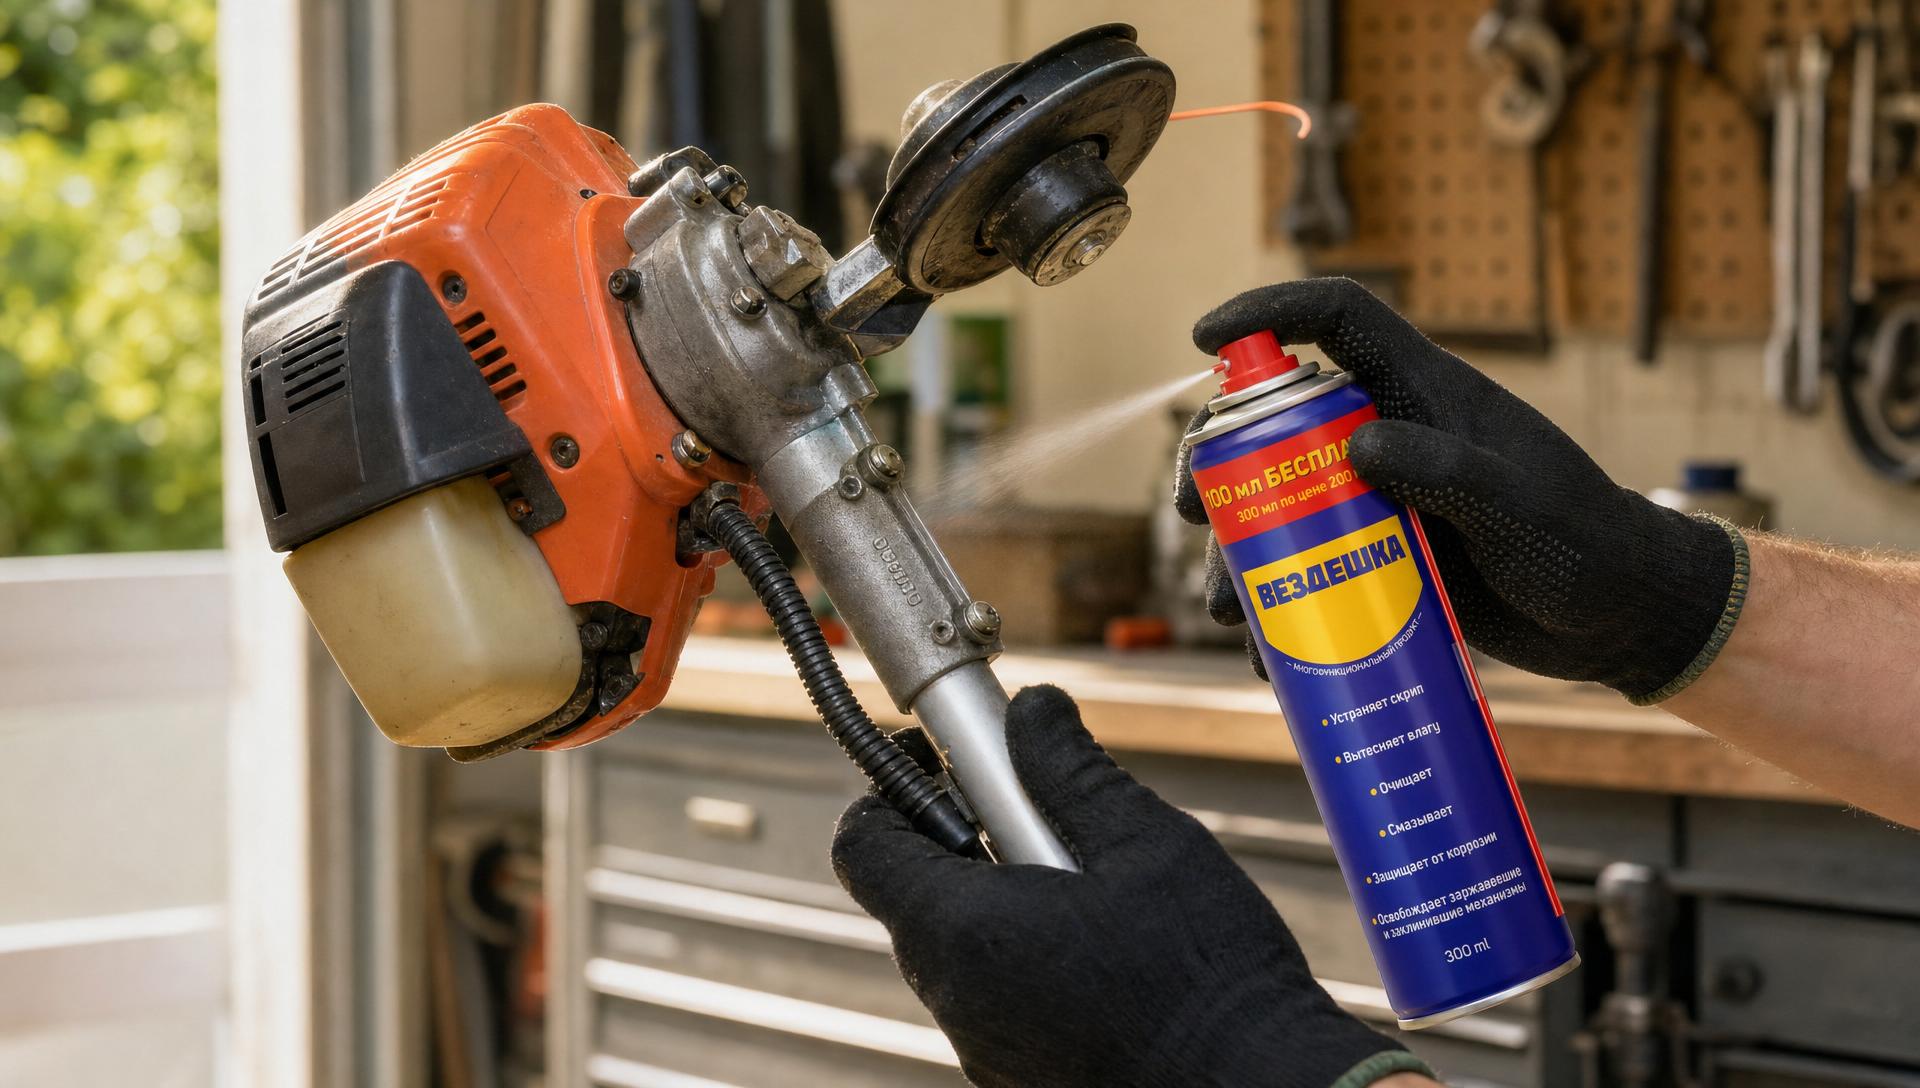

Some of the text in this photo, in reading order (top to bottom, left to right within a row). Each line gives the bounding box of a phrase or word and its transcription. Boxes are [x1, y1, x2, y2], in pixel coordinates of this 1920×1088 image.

[1205, 436, 1352, 509] 100 мл БЕСПЛА
[1236, 507, 1260, 523] 300
[1262, 500, 1278, 515] мл
[1280, 494, 1296, 509] по
[1297, 482, 1328, 505] цене
[1328, 469, 1352, 489] 200
[1256, 534, 1406, 610] ВЕЗДЕШКА
[1329, 683, 1425, 726] Устраняет скрип
[1343, 720, 1441, 764] Вытесняет влагу
[1379, 767, 1433, 795] Очищает
[1387, 805, 1453, 836] Смазывает
[1372, 831, 1498, 885] Защищает от коррозии
[1377, 896, 1447, 925] Освобождает
[1383, 882, 1527, 940] и заклинившие механизмы
[1444, 937, 1491, 964] 300 ml
